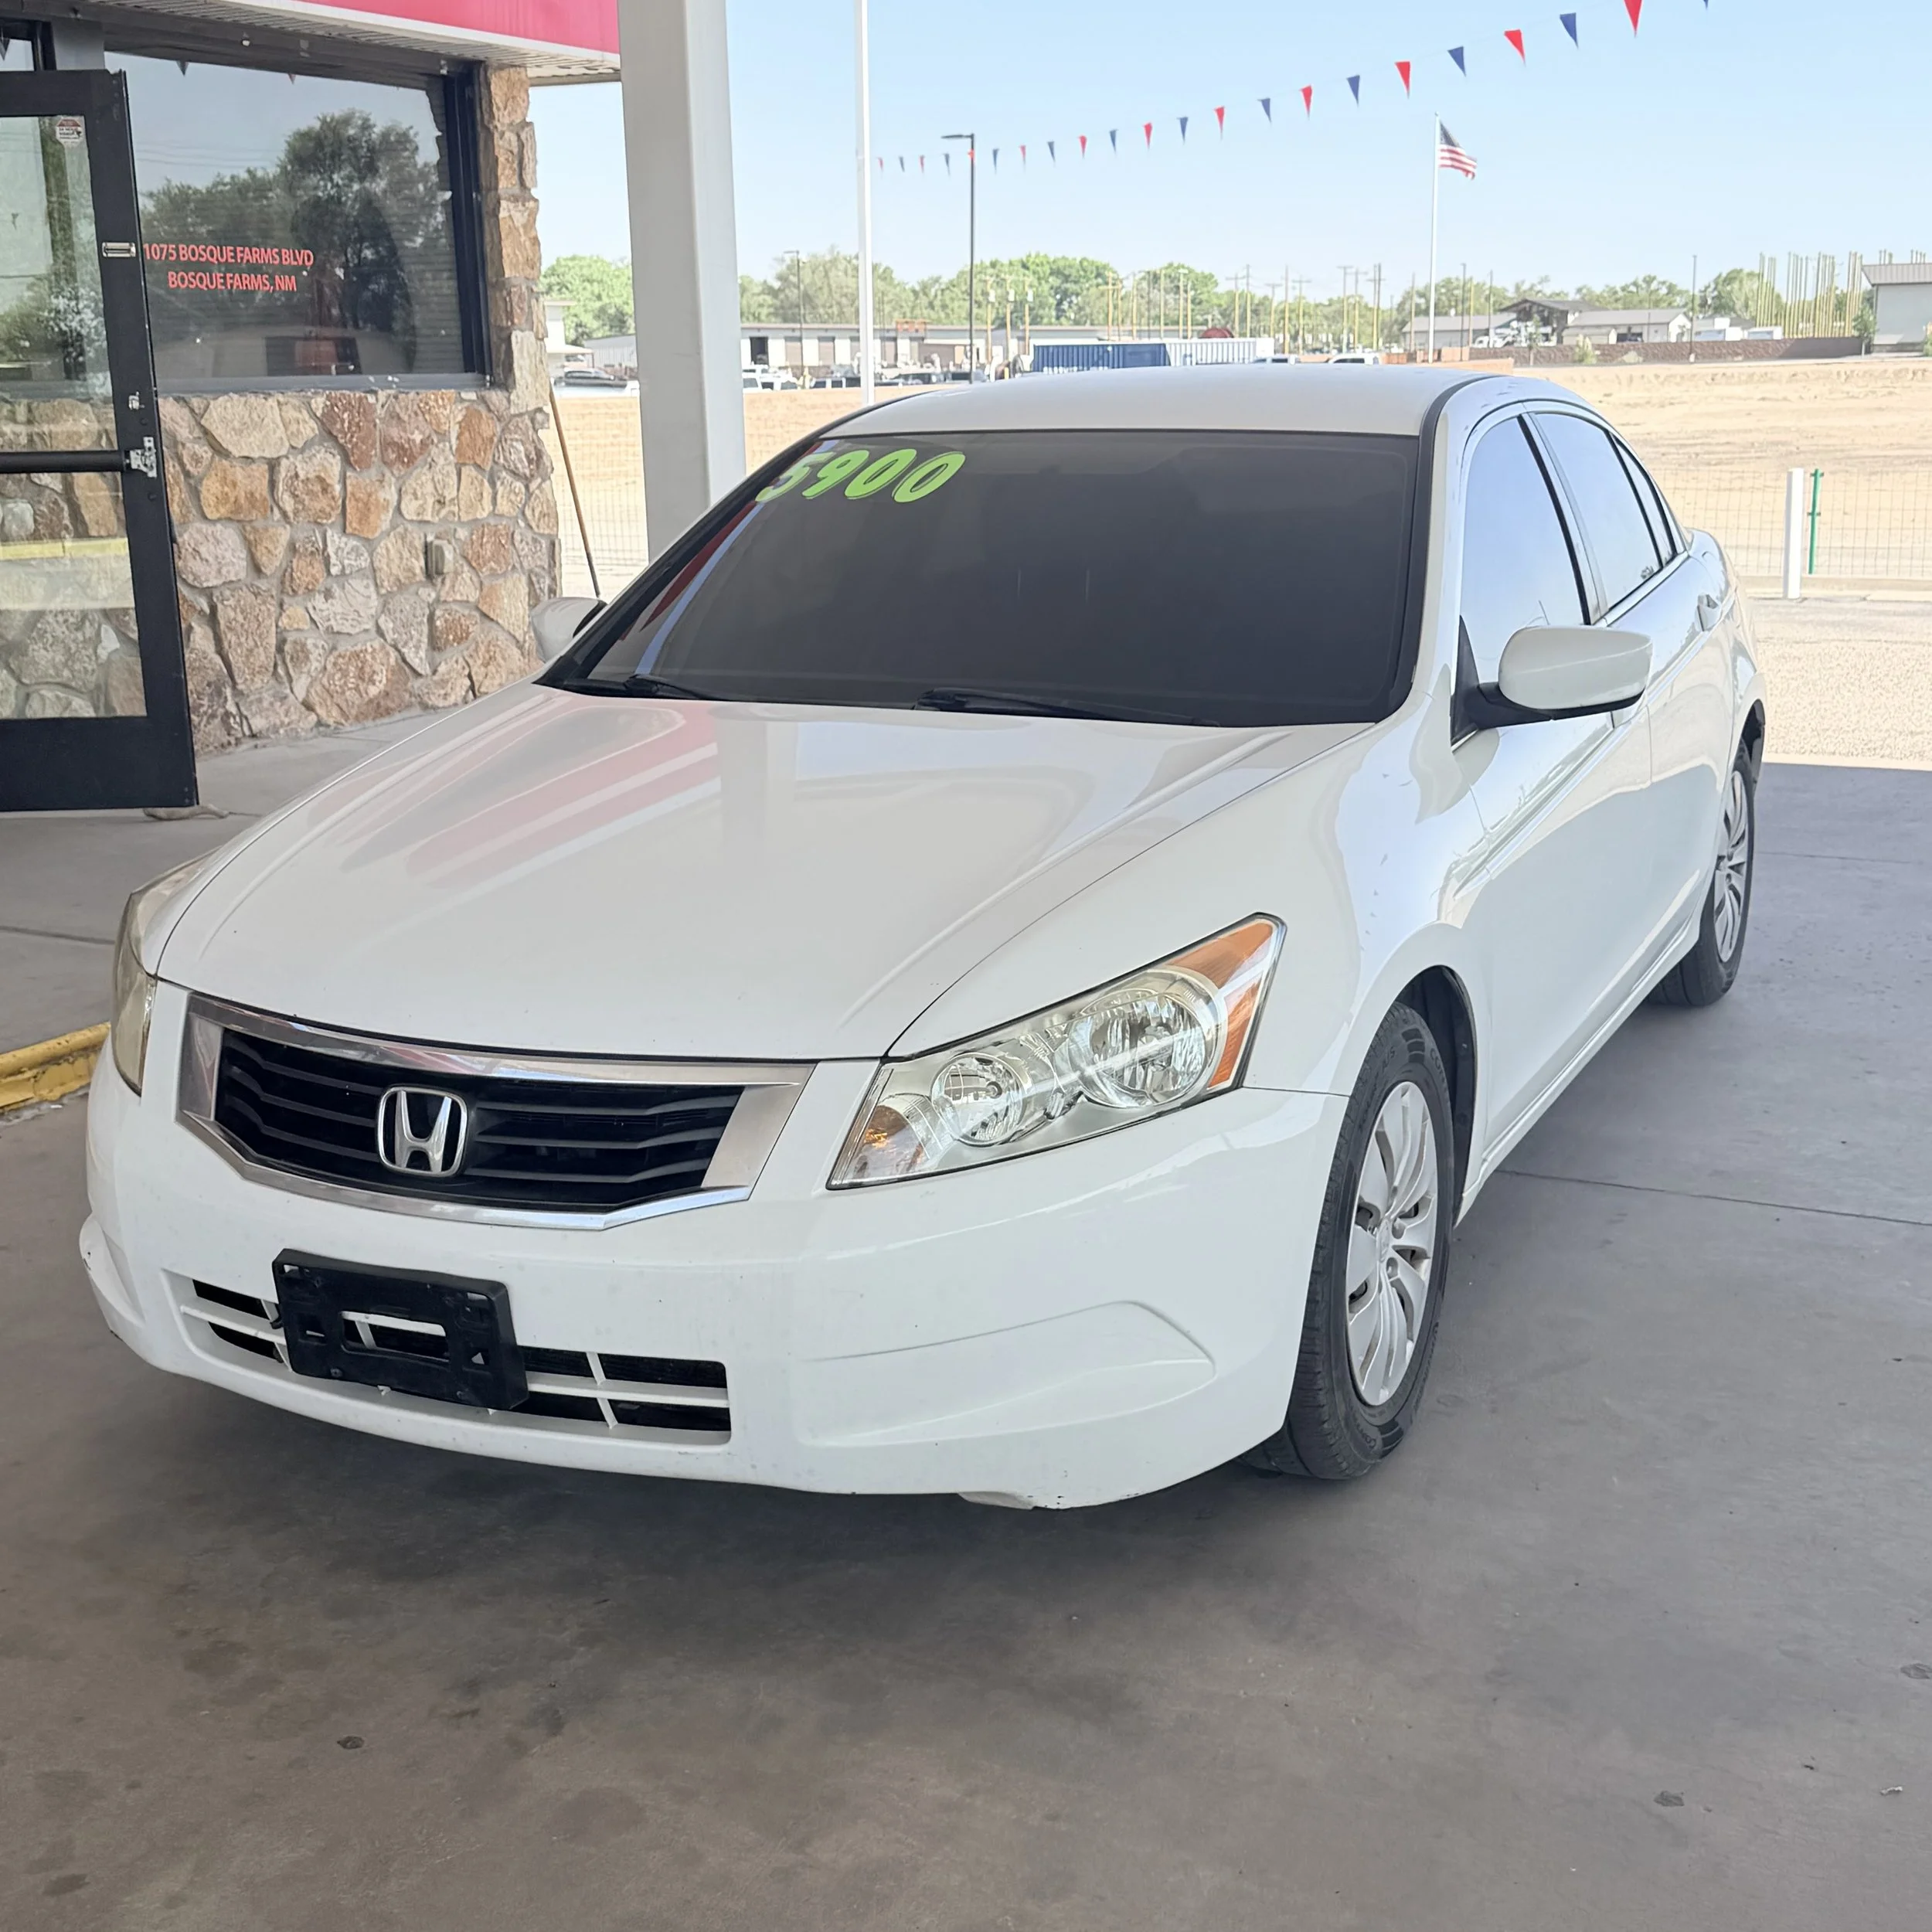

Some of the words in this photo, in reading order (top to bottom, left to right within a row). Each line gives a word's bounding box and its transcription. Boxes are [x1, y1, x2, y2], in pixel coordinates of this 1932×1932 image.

[143, 243, 176, 261] 1075
[179, 244, 235, 264] BOSQUE
[236, 247, 280, 265] FARMS
[281, 248, 315, 267] BLVD
[168, 271, 224, 291] BOSQUE
[226, 273, 274, 293] FARMS,
[275, 274, 298, 292] NM
[754, 448, 966, 503] 5900
